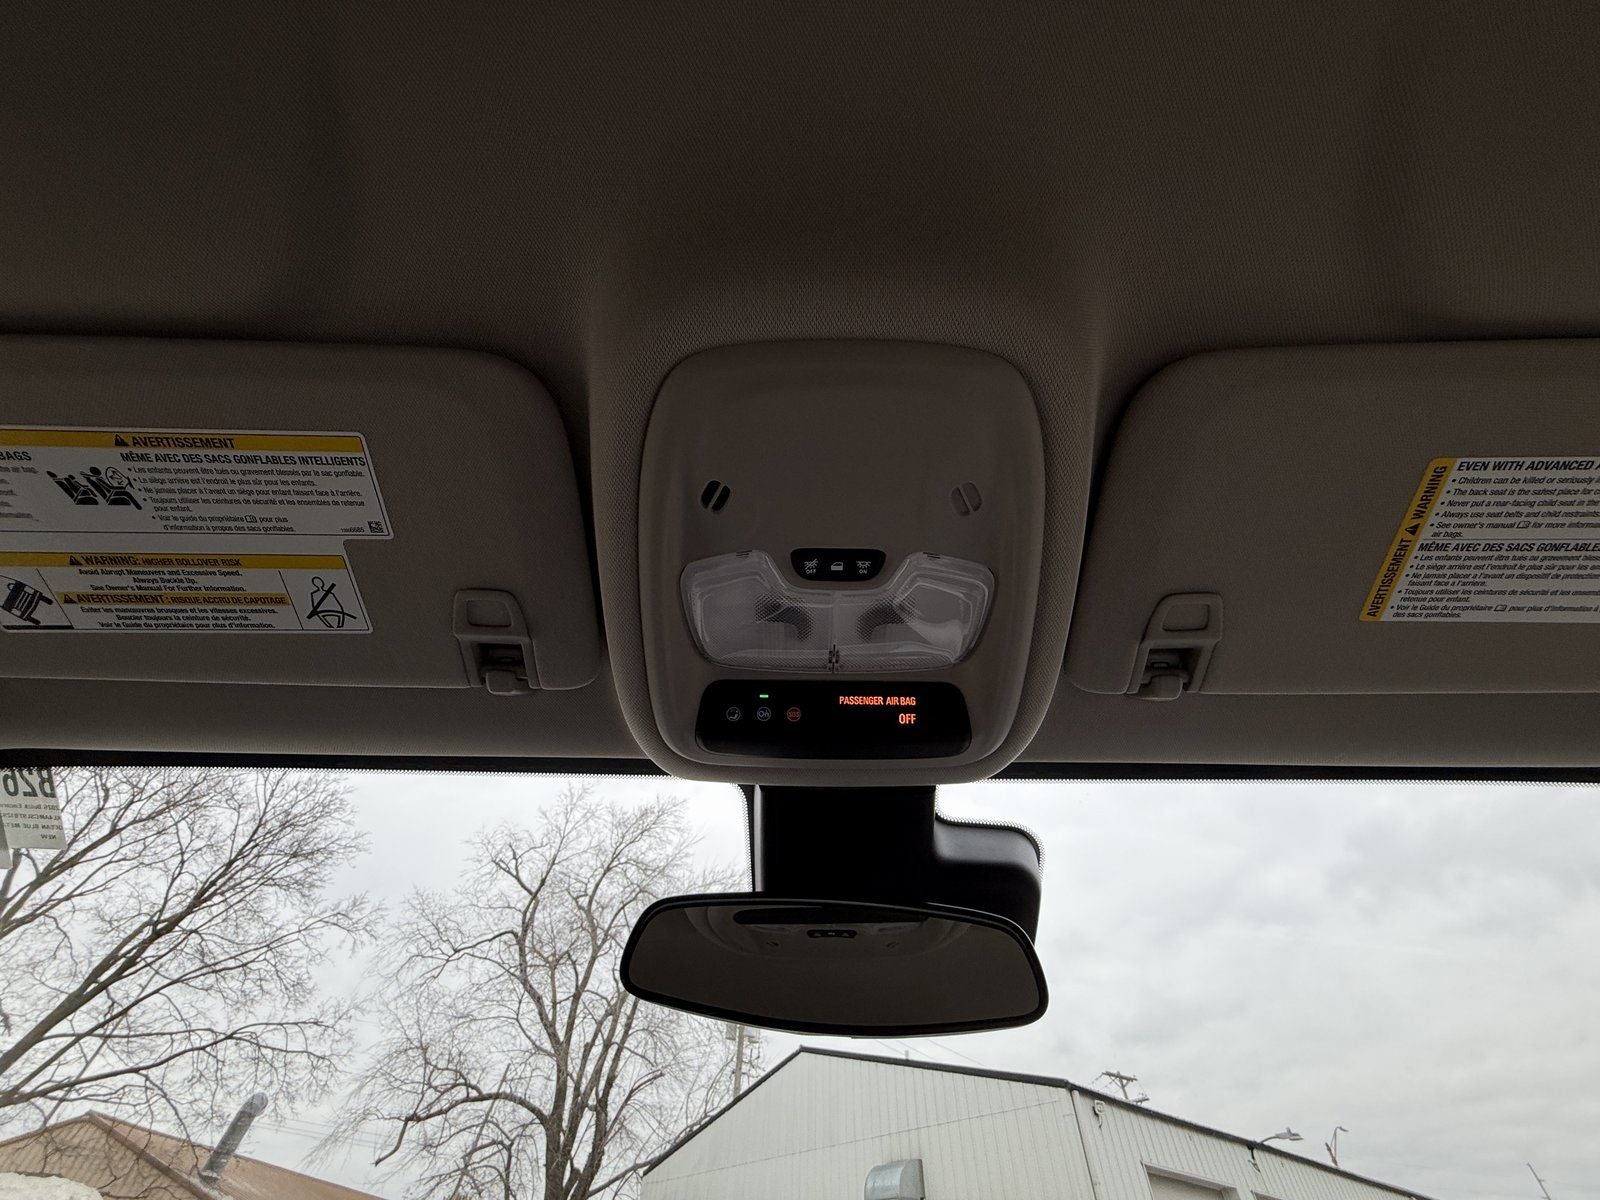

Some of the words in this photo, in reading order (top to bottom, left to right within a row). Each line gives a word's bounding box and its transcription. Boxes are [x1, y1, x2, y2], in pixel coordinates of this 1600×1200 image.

[131, 436, 235, 449] AVERTISSEMENT
[120, 450, 153, 462] MÊME
[154, 452, 181, 462] AVEC
[182, 454, 204, 463] DES
[204, 454, 232, 464] SACS
[232, 454, 297, 465] GONFLABLES
[298, 456, 366, 466] INTELLIGENTS
[1457, 461, 1490, 471] EVEN
[1492, 461, 1525, 470] WITH
[1525, 461, 1594, 470] ADVANCED
[1556, 476, 1595, 485] seriously
[1411, 465, 1448, 520] WARNING
[1453, 488, 1468, 496] The
[1470, 500, 1485, 508] put
[1441, 511, 1470, 519] Always
[1417, 541, 1451, 552] MÊME
[1451, 542, 1481, 552] AVEC
[1482, 542, 1504, 552] DES
[1505, 542, 1536, 552] SACS
[1536, 542, 1600, 552] GONFLABLE
[82, 556, 140, 566] WARNING:
[142, 558, 174, 566] HIGHER
[176, 558, 220, 566] ROLLOVER
[221, 558, 242, 566] RISK
[1366, 538, 1412, 618] AVERTISSEMENT
[1404, 589, 1434, 597] Toujours
[839, 696, 884, 706] PASSENGER
[885, 696, 900, 706] AIR
[900, 696, 916, 706] BAG
[898, 713, 916, 725] OFF
